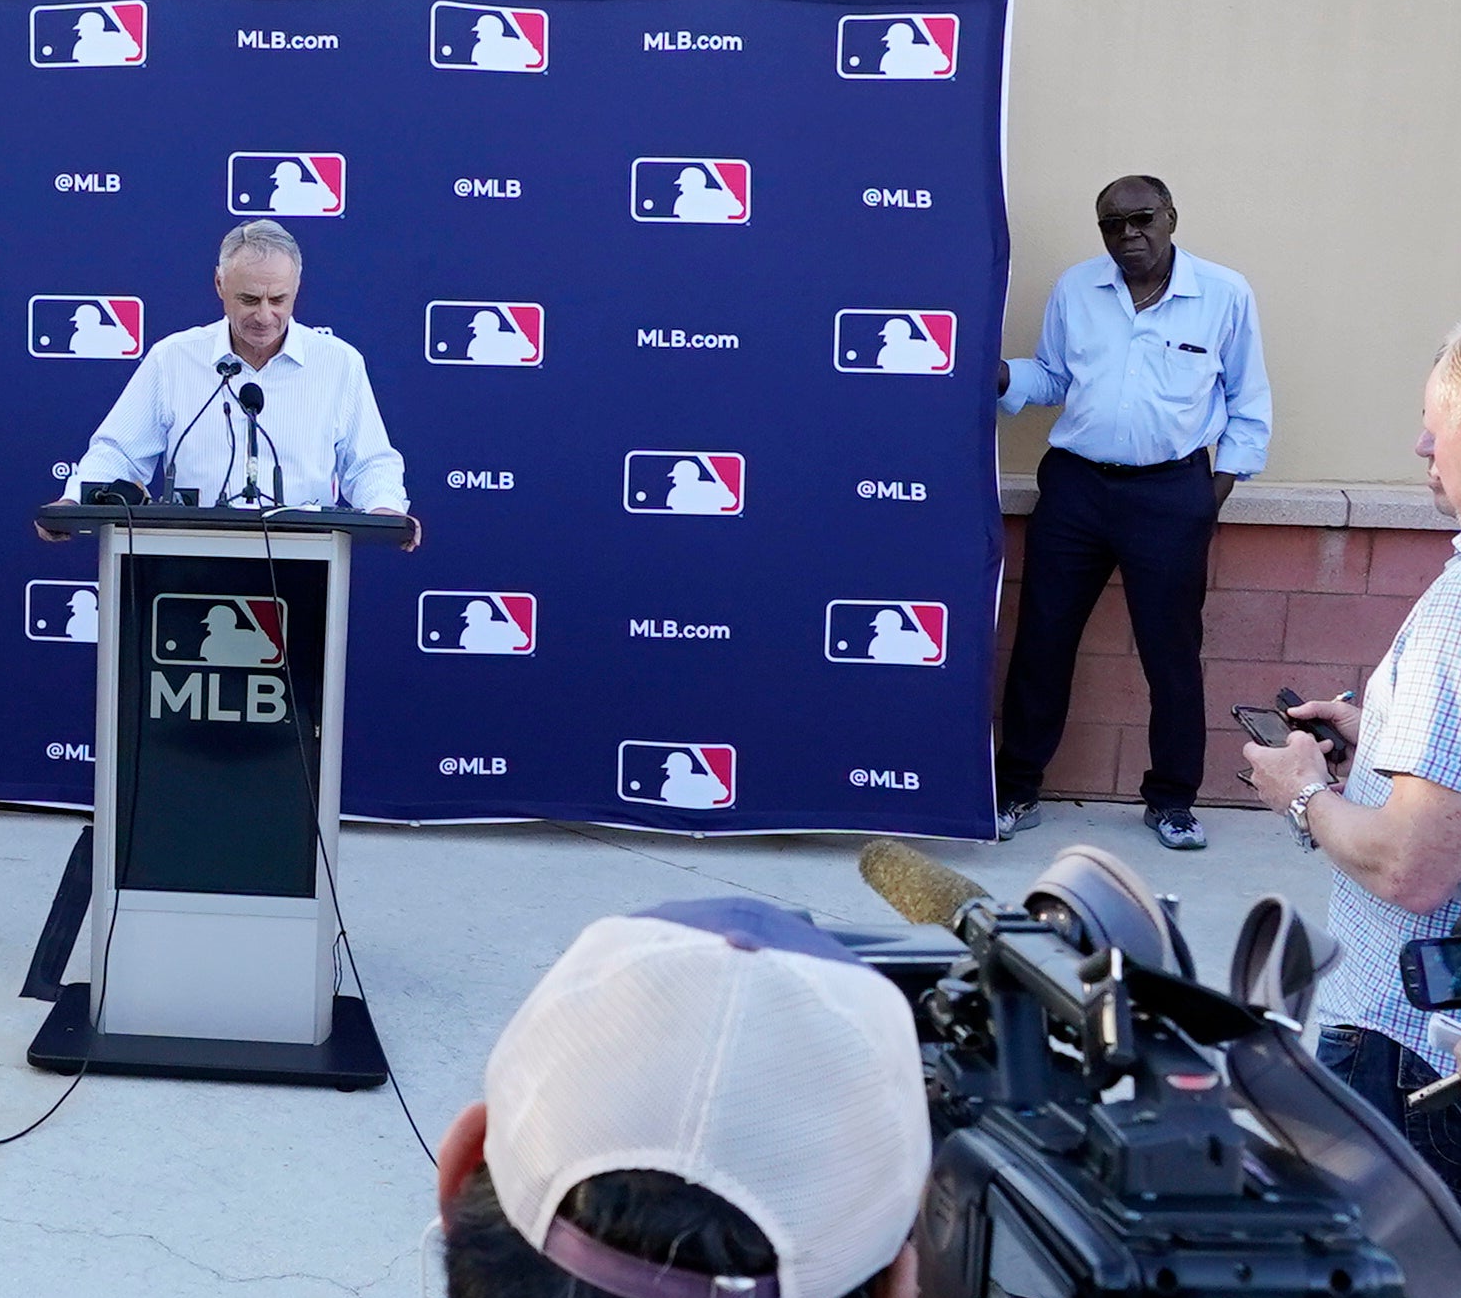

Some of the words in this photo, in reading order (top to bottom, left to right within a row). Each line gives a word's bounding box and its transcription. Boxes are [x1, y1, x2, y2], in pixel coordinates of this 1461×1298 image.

[238, 29, 339, 50] MLB.com
[643, 30, 743, 51] MLB.com
[54, 173, 121, 193] @MLB
[453, 178, 522, 198] @MLB
[862, 188, 932, 209] @MLB
[637, 328, 739, 349] MLB.com
[446, 470, 515, 490] @MLB
[856, 480, 927, 501] @MLB
[629, 619, 731, 640] MLB.com
[150, 671, 287, 723] MLB
[46, 742, 95, 762] @ML
[439, 757, 507, 775] @MLB
[849, 768, 920, 790] @MLB
